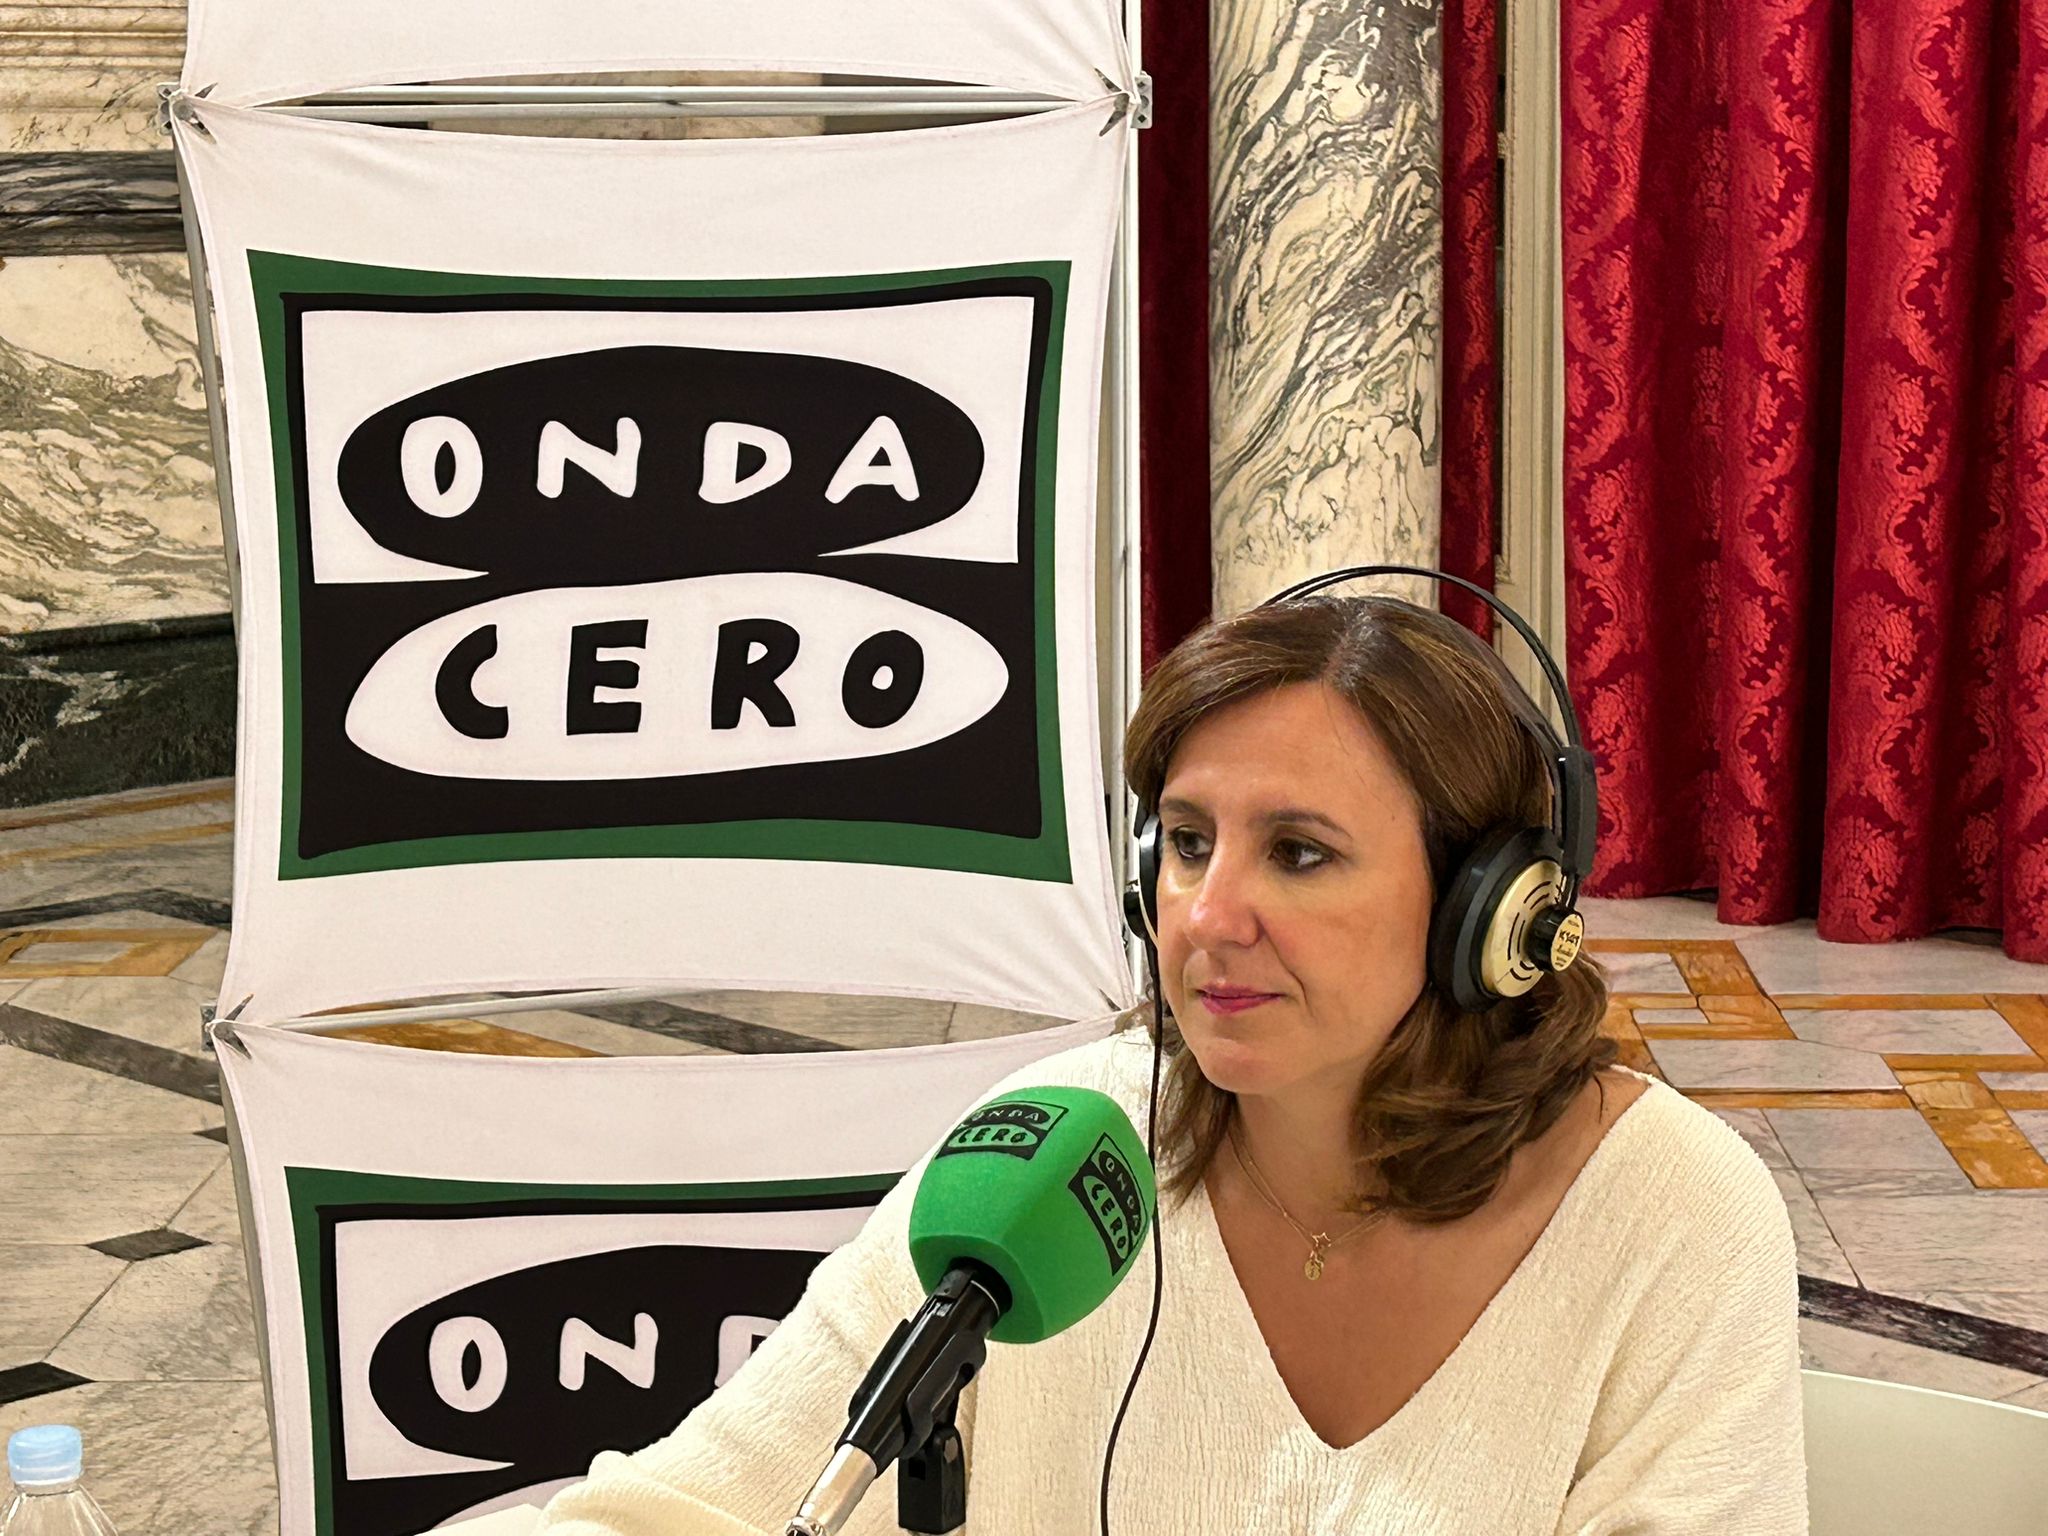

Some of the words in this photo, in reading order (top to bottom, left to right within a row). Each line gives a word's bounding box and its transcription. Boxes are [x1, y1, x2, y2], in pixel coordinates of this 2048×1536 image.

[401, 416, 919, 518] ONDA
[435, 619, 924, 739] CERO
[958, 1127, 1028, 1144] CERO
[971, 1108, 1040, 1122] ONDA
[1091, 1184, 1127, 1249] CERO
